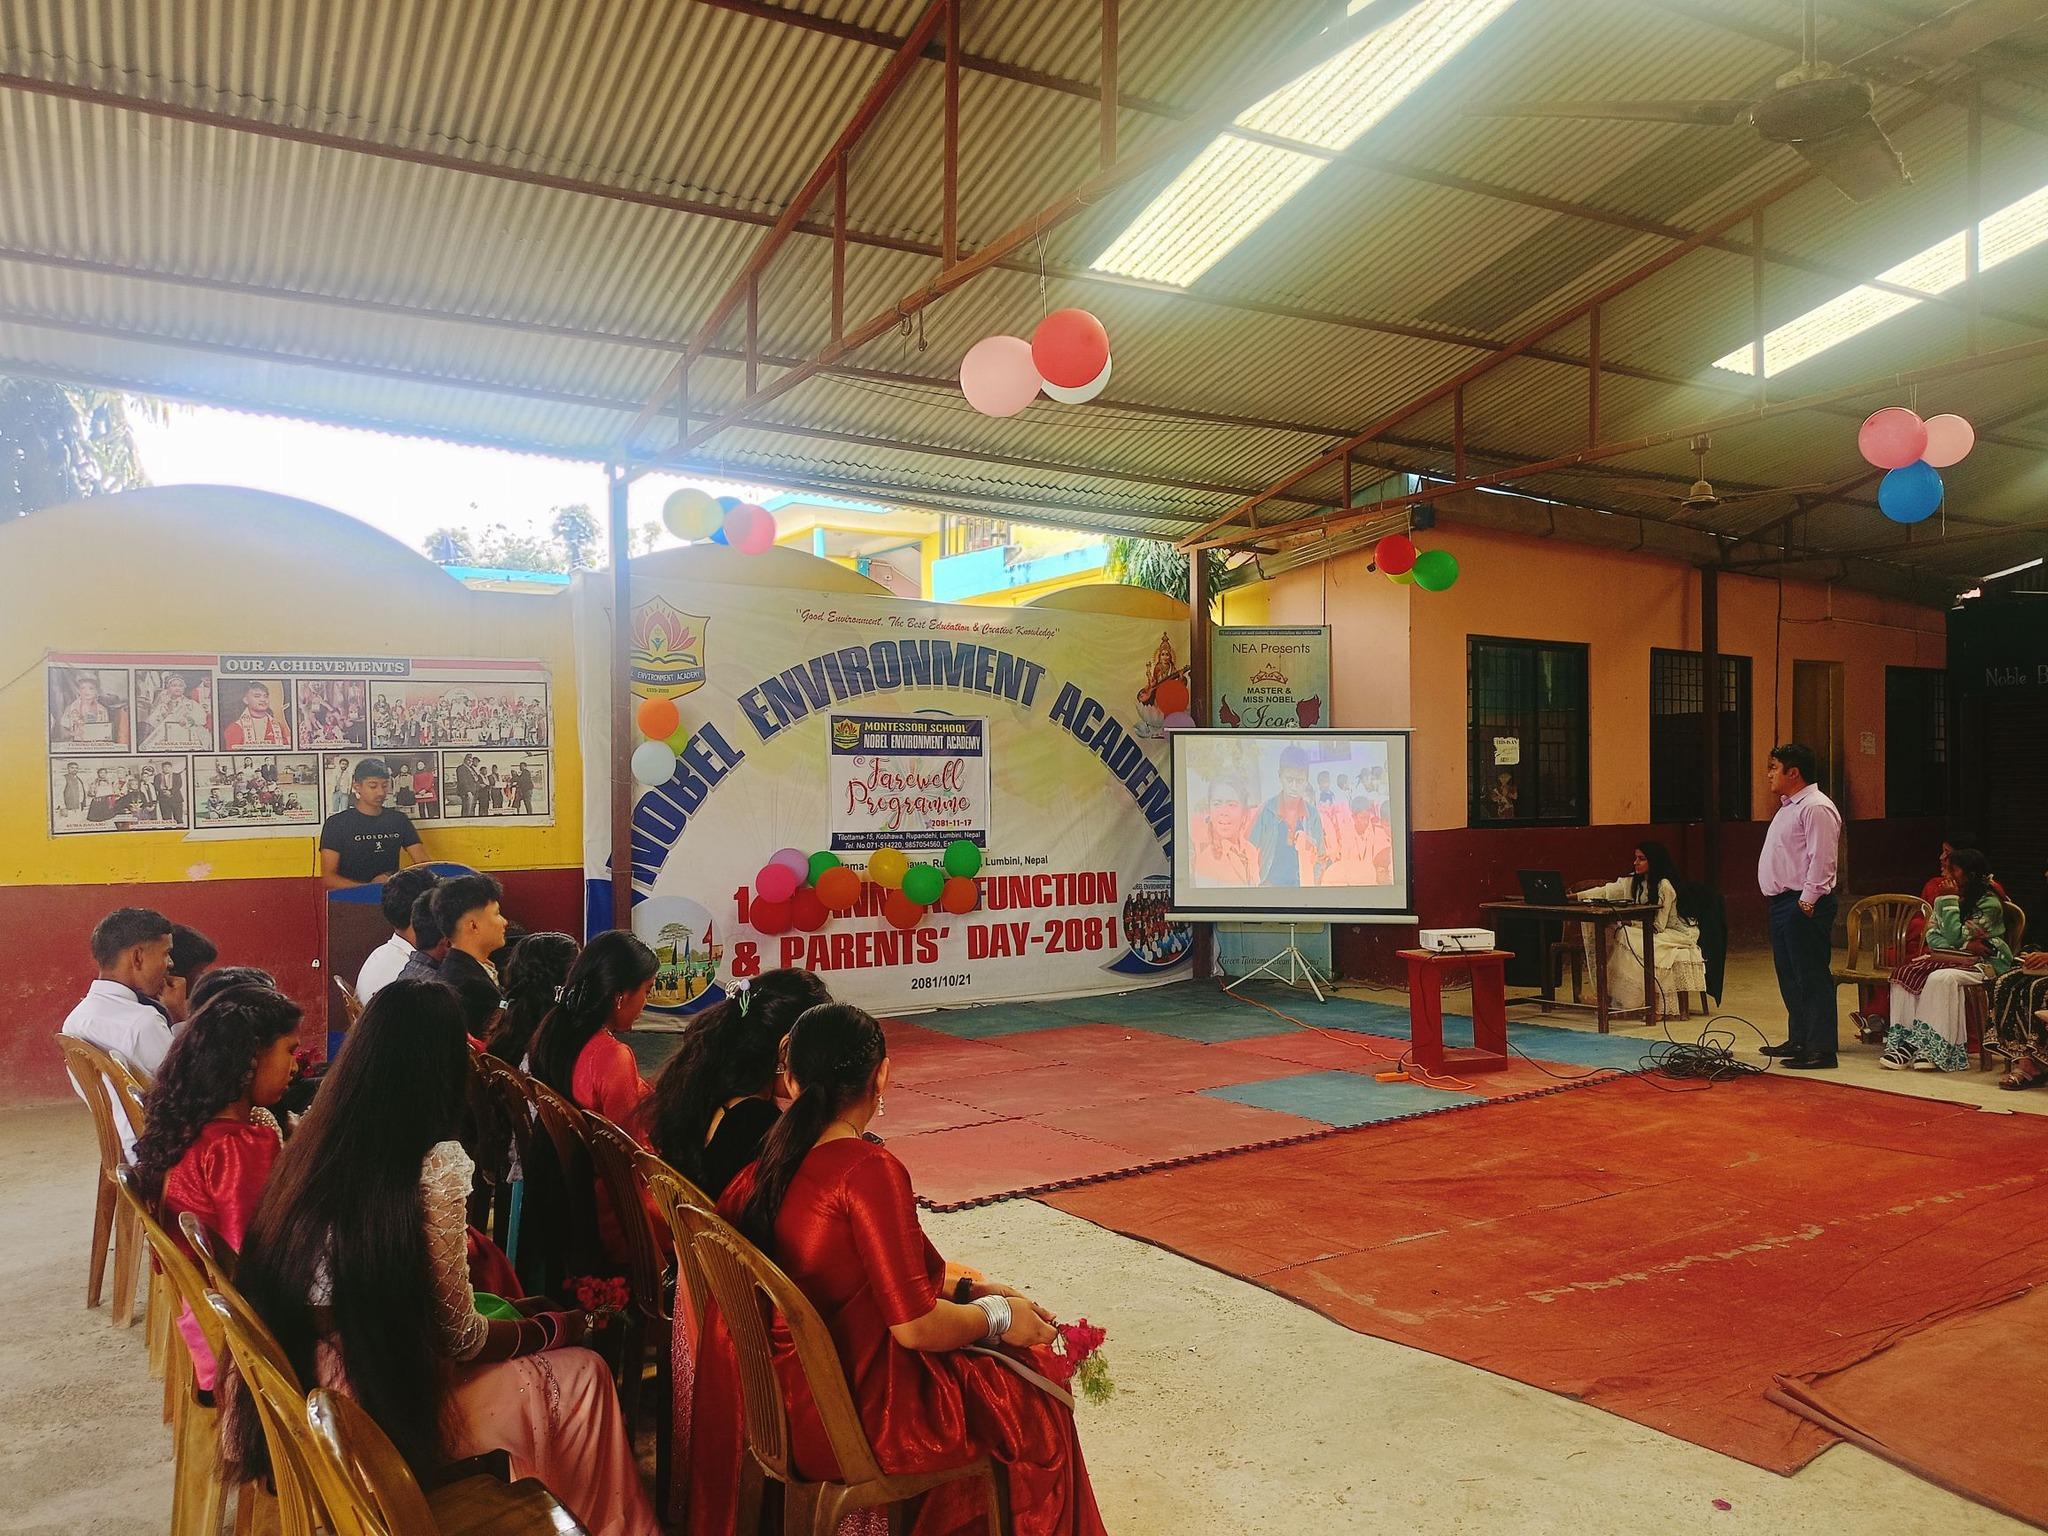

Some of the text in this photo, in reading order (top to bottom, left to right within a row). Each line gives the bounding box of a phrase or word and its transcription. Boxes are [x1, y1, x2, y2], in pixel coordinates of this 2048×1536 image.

[888, 616, 903, 627] The
[907, 618, 926, 628] Best
[929, 619, 969, 631] Education
[973, 622, 979, 631] &
[982, 623, 1013, 634] Creative
[1232, 643, 1311, 654] NEA Presents
[226, 659, 405, 673] OUR ACHIEVEMENTS
[637, 671, 674, 681] ENVIRONMENT
[677, 671, 701, 680] ACADEMY
[1985, 666, 2026, 688] Noble
[864, 722, 967, 733] MONTESSORI SCHOOL
[737, 639, 1046, 742] ENVIRONMENT
[1049, 681, 1173, 858] ACADEM
[864, 734, 981, 750] NOBEL ENVIRONMENT ACADEMY
[867, 757, 966, 791] Farewell
[847, 777, 970, 830] Programme
[931, 819, 972, 827] 2081-11-17
[906, 832, 938, 840] Rupandehi,
[985, 855, 1048, 867] Lumbini, Nepal
[973, 871, 1118, 913] FUNCTION
[731, 941, 761, 977] &
[967, 916, 1118, 960] DAY-2081
[911, 973, 971, 990] 2081/10/21
